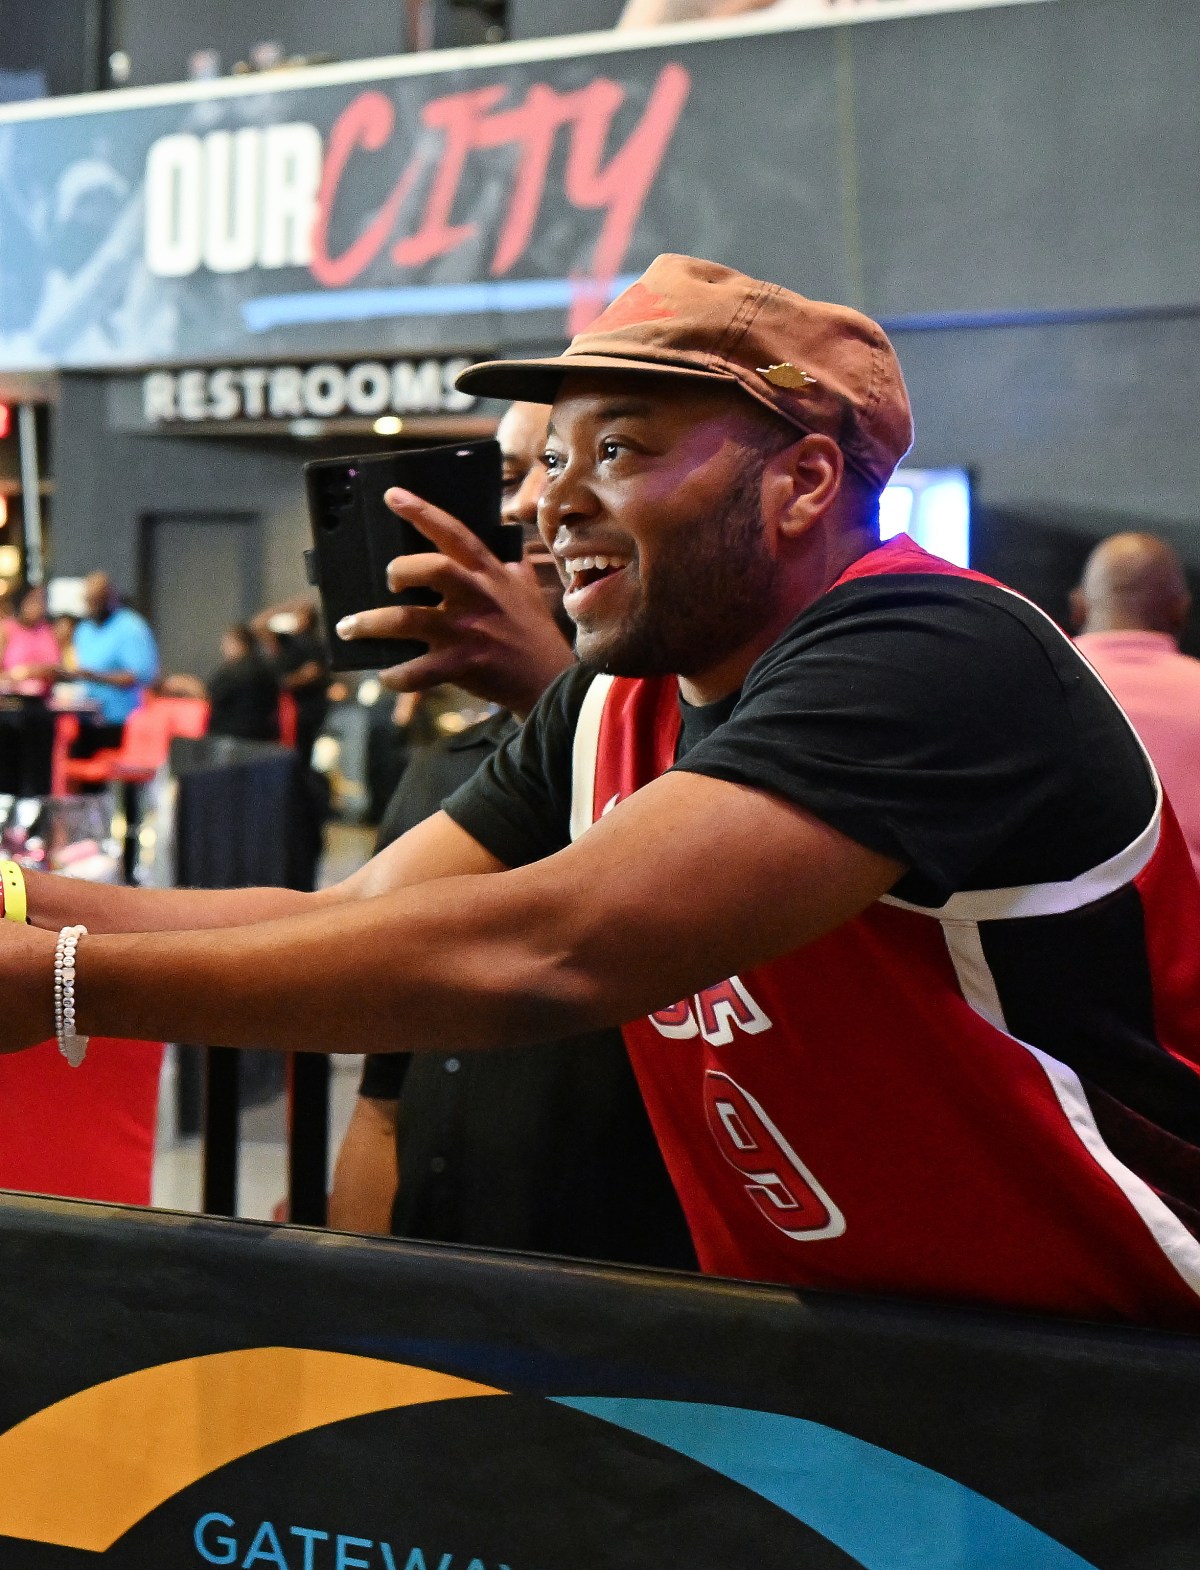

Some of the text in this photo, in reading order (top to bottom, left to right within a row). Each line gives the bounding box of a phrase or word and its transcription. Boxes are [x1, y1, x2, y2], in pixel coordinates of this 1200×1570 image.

[145, 62, 691, 337] OUR CITY
[143, 356, 478, 422] RESTROOMS
[703, 1069, 847, 1242] 9
[193, 1511, 511, 1570] GATEW
